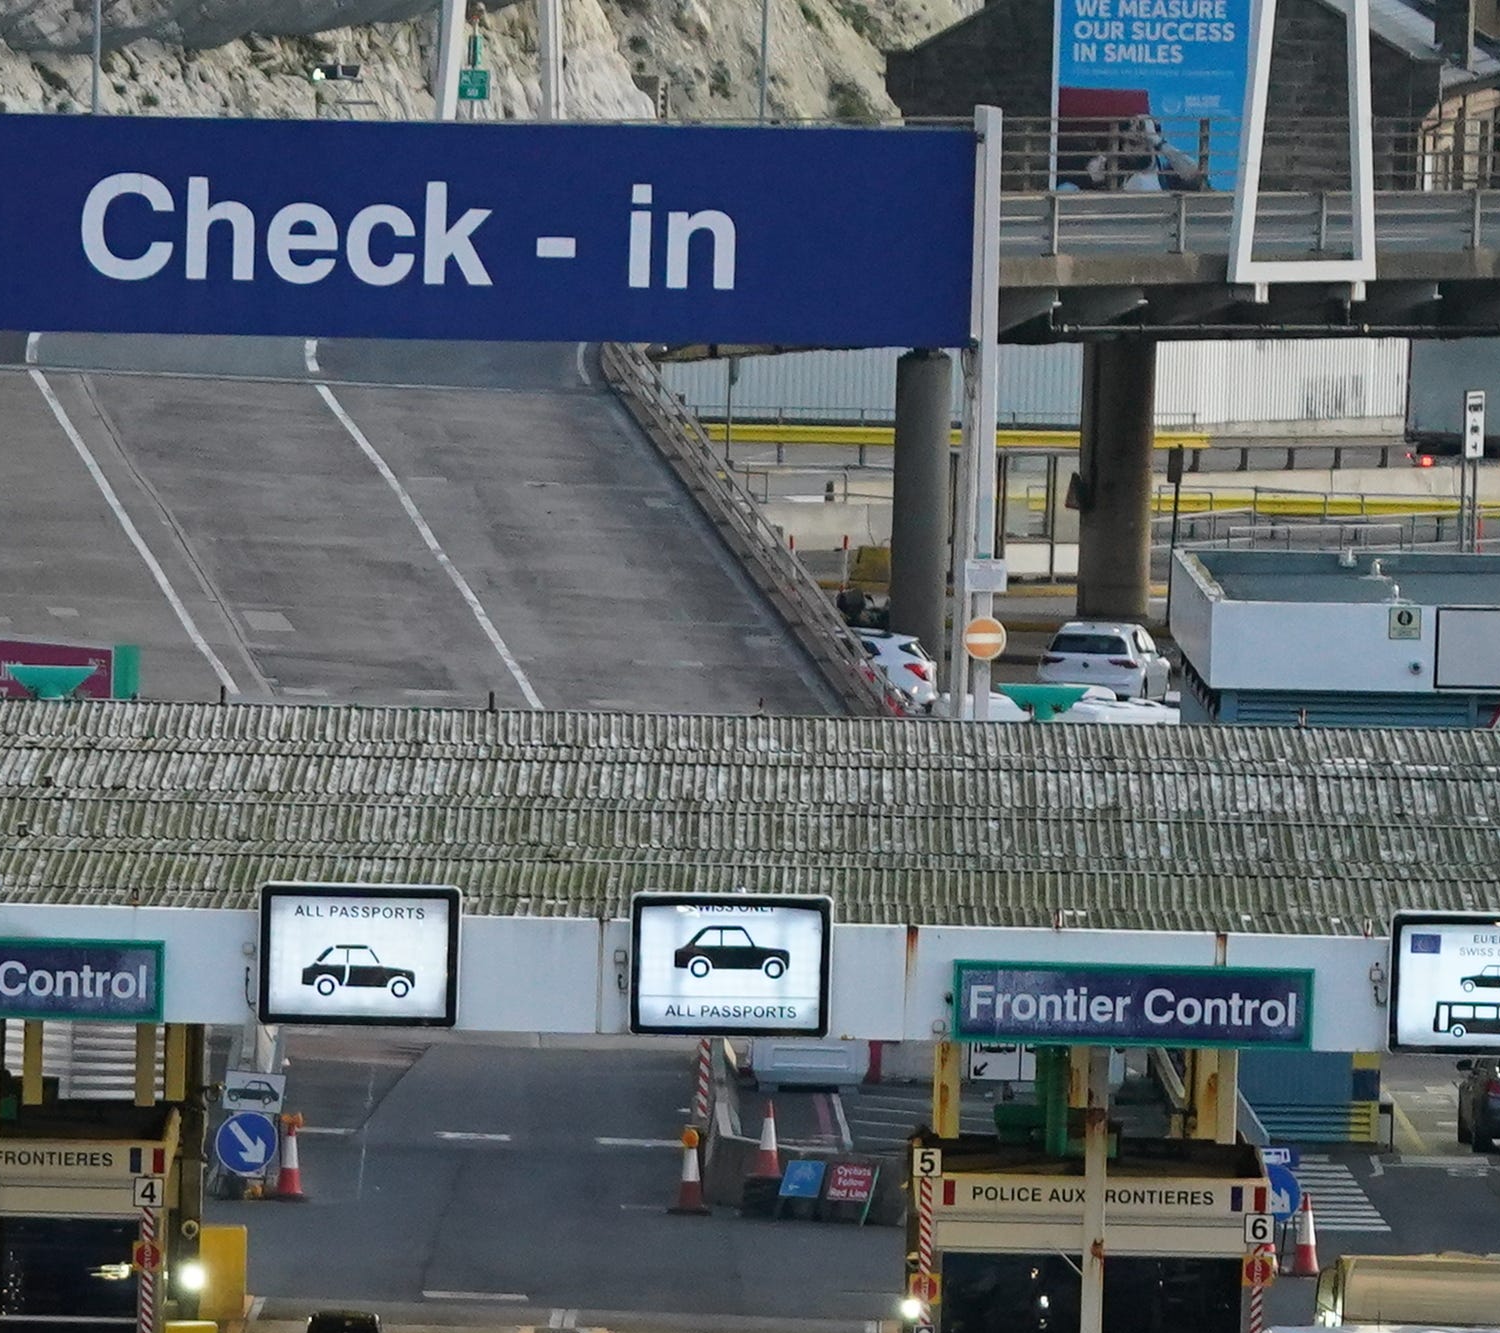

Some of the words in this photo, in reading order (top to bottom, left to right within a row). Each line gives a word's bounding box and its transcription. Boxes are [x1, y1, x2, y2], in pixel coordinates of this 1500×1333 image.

[1076, 0, 1111, 17] WE
[1118, 0, 1226, 20] MEASURE
[1074, 20, 1124, 40] OUR
[1131, 22, 1236, 42] SUCCESS
[1073, 42, 1097, 63] IN
[1104, 44, 1183, 64] SMILES
[80, 172, 492, 285] Check
[627, 184, 736, 290] in
[295, 905, 324, 918] ALL
[329, 905, 425, 919] PASSPORTS
[1459, 946, 1493, 957] SWISS
[665, 1005, 696, 1018] ALL
[701, 1005, 797, 1020] PASSPORTS
[969, 984, 1130, 1023] Frontier
[1144, 989, 1295, 1027] Control
[919, 1153, 935, 1174] 5
[140, 1183, 156, 1203] 4
[972, 1186, 1042, 1203] POLICE
[1049, 1187, 1085, 1203] AUX
[1105, 1189, 1214, 1206] RONTIERES
[1252, 1218, 1267, 1239] 6
